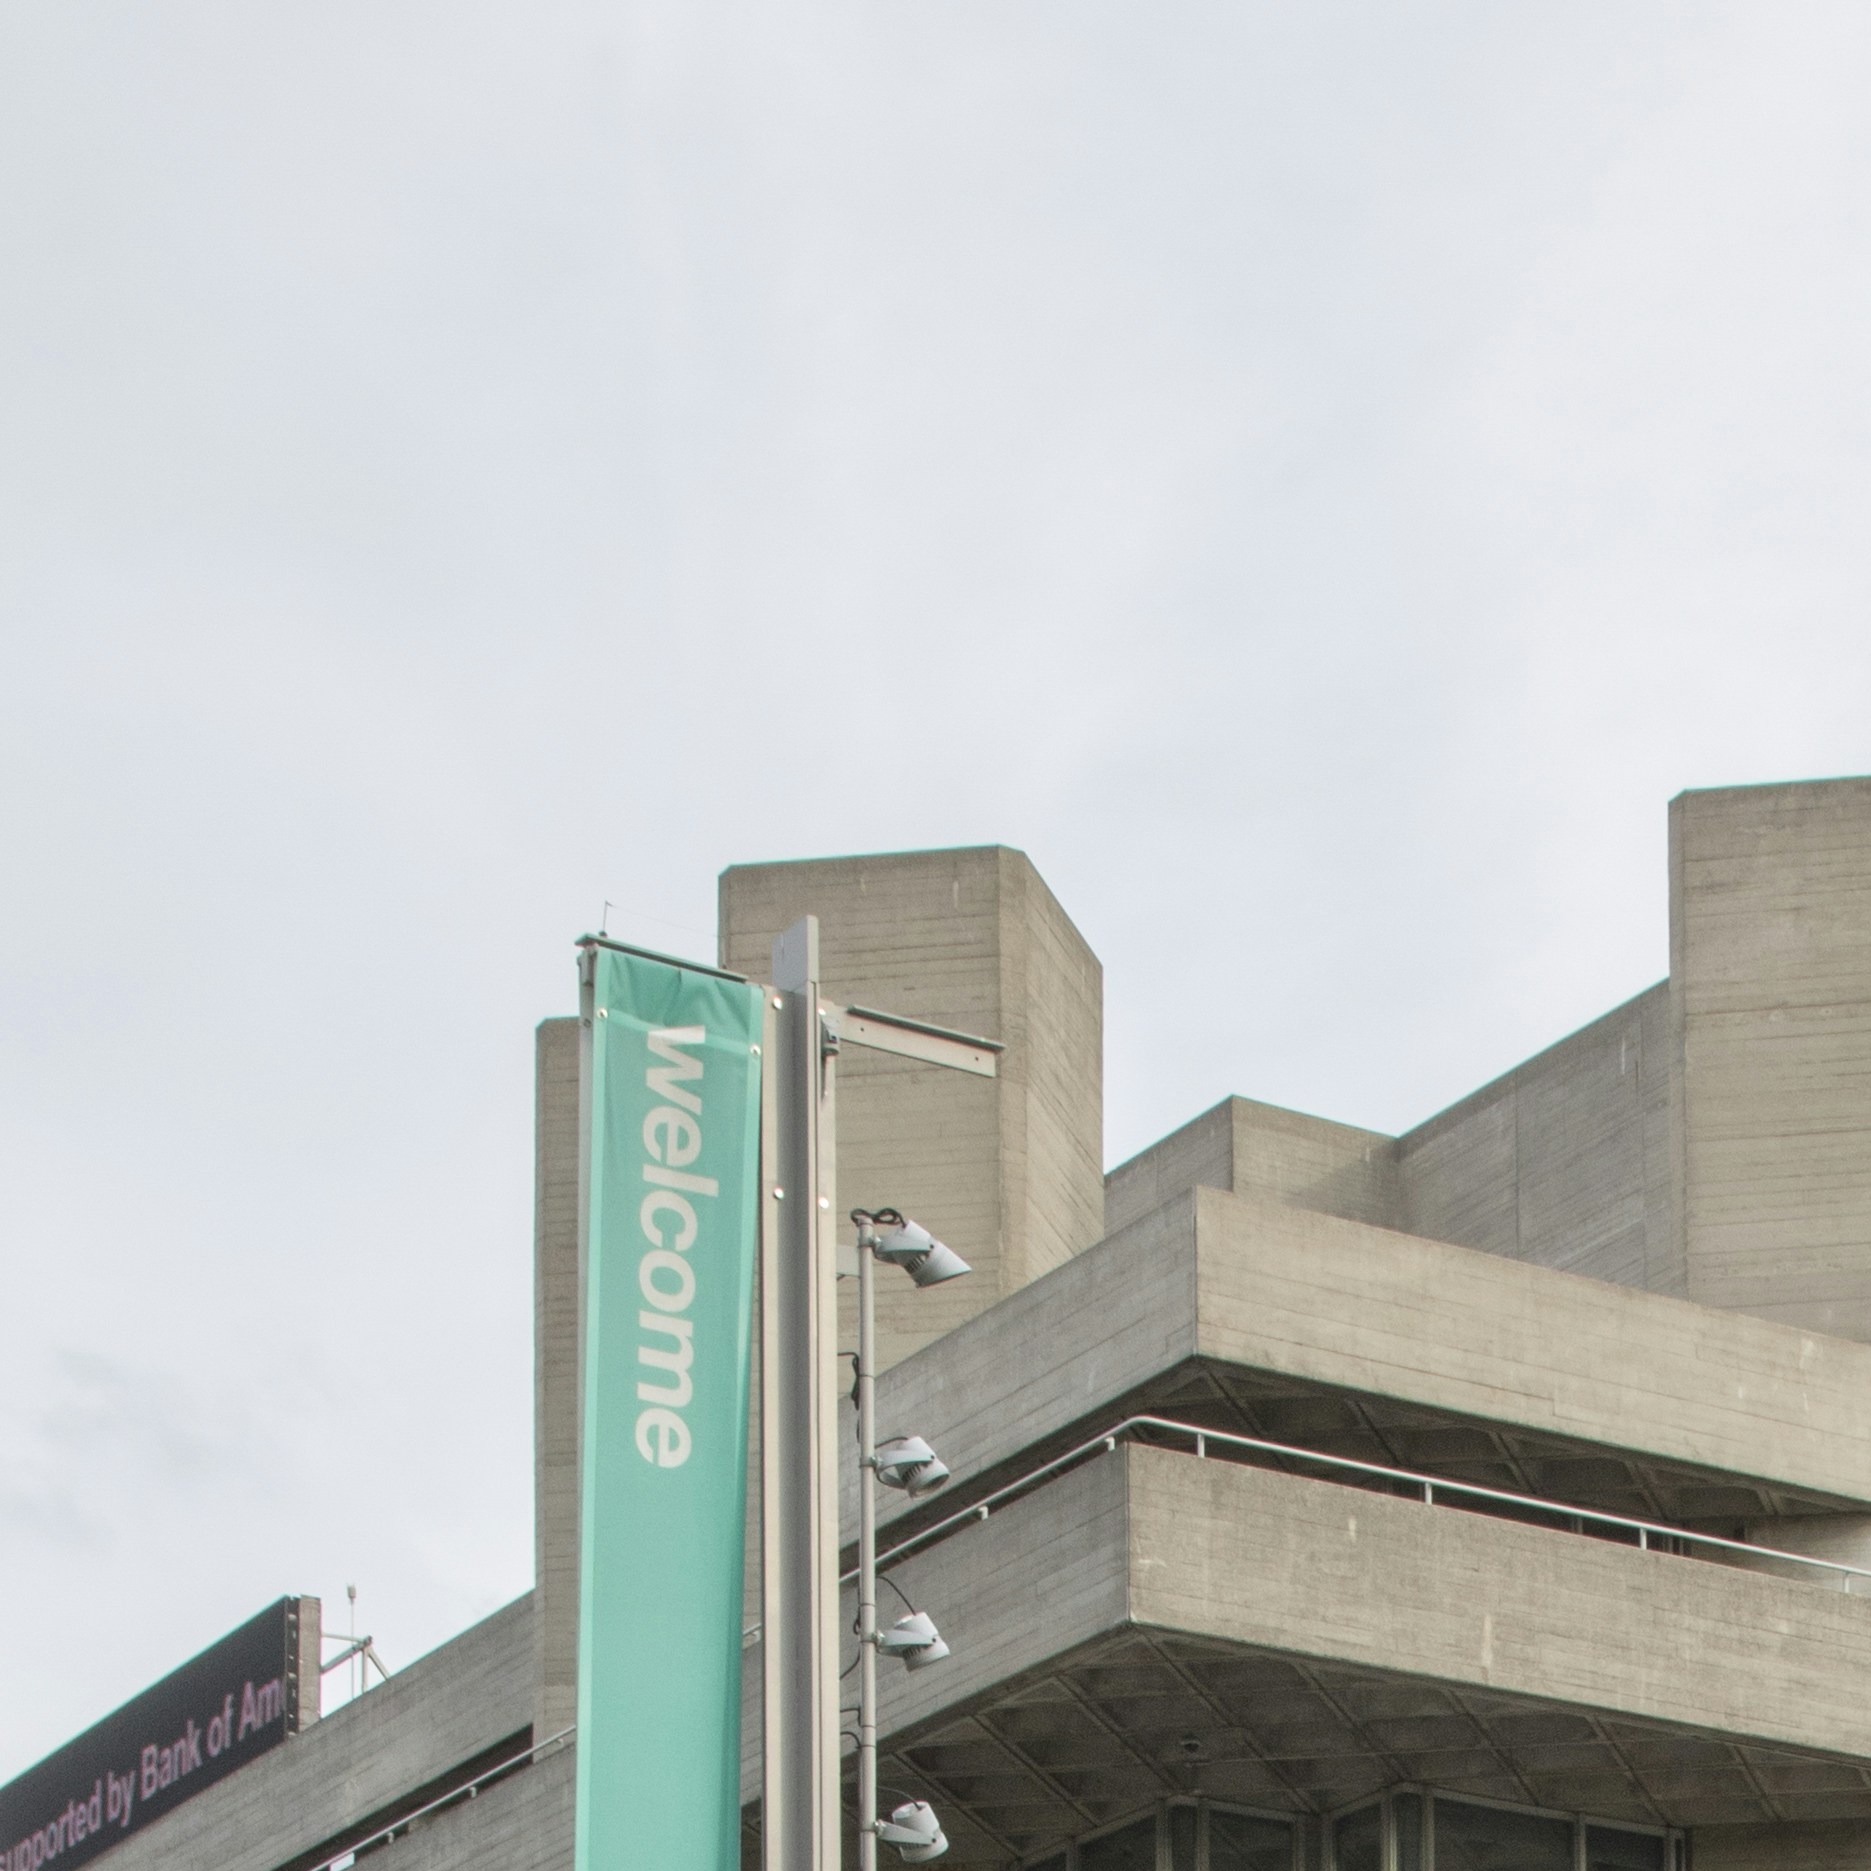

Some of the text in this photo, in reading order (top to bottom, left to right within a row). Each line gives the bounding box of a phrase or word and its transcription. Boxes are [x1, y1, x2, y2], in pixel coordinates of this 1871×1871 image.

[634, 1024, 720, 1469] welcome
[106, 1770, 136, 1828] by
[140, 1718, 201, 1801] Bank
[206, 1693, 234, 1758] of
